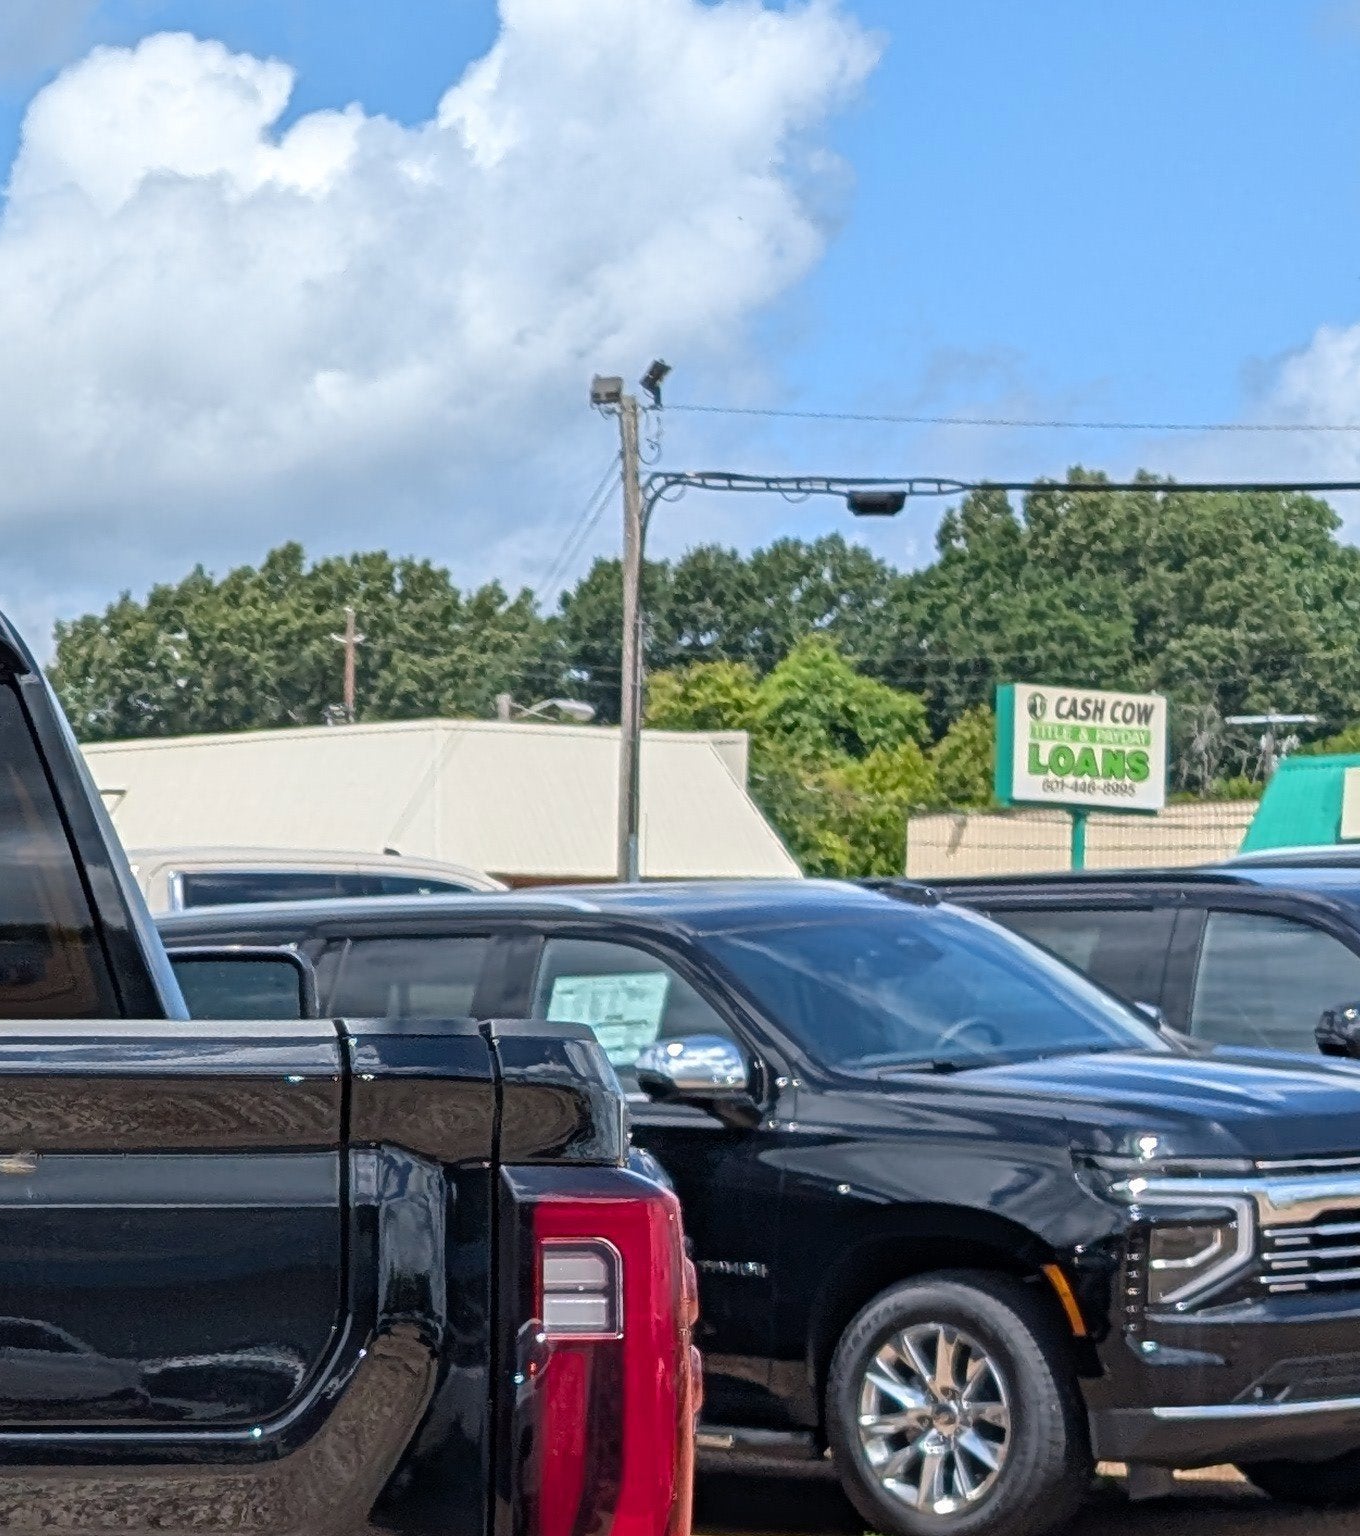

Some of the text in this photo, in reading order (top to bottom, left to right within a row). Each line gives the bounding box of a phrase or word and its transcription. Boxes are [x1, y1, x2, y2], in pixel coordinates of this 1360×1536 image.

[1055, 696, 1154, 726] CASH COW
[1028, 743, 1150, 782] LOANS
